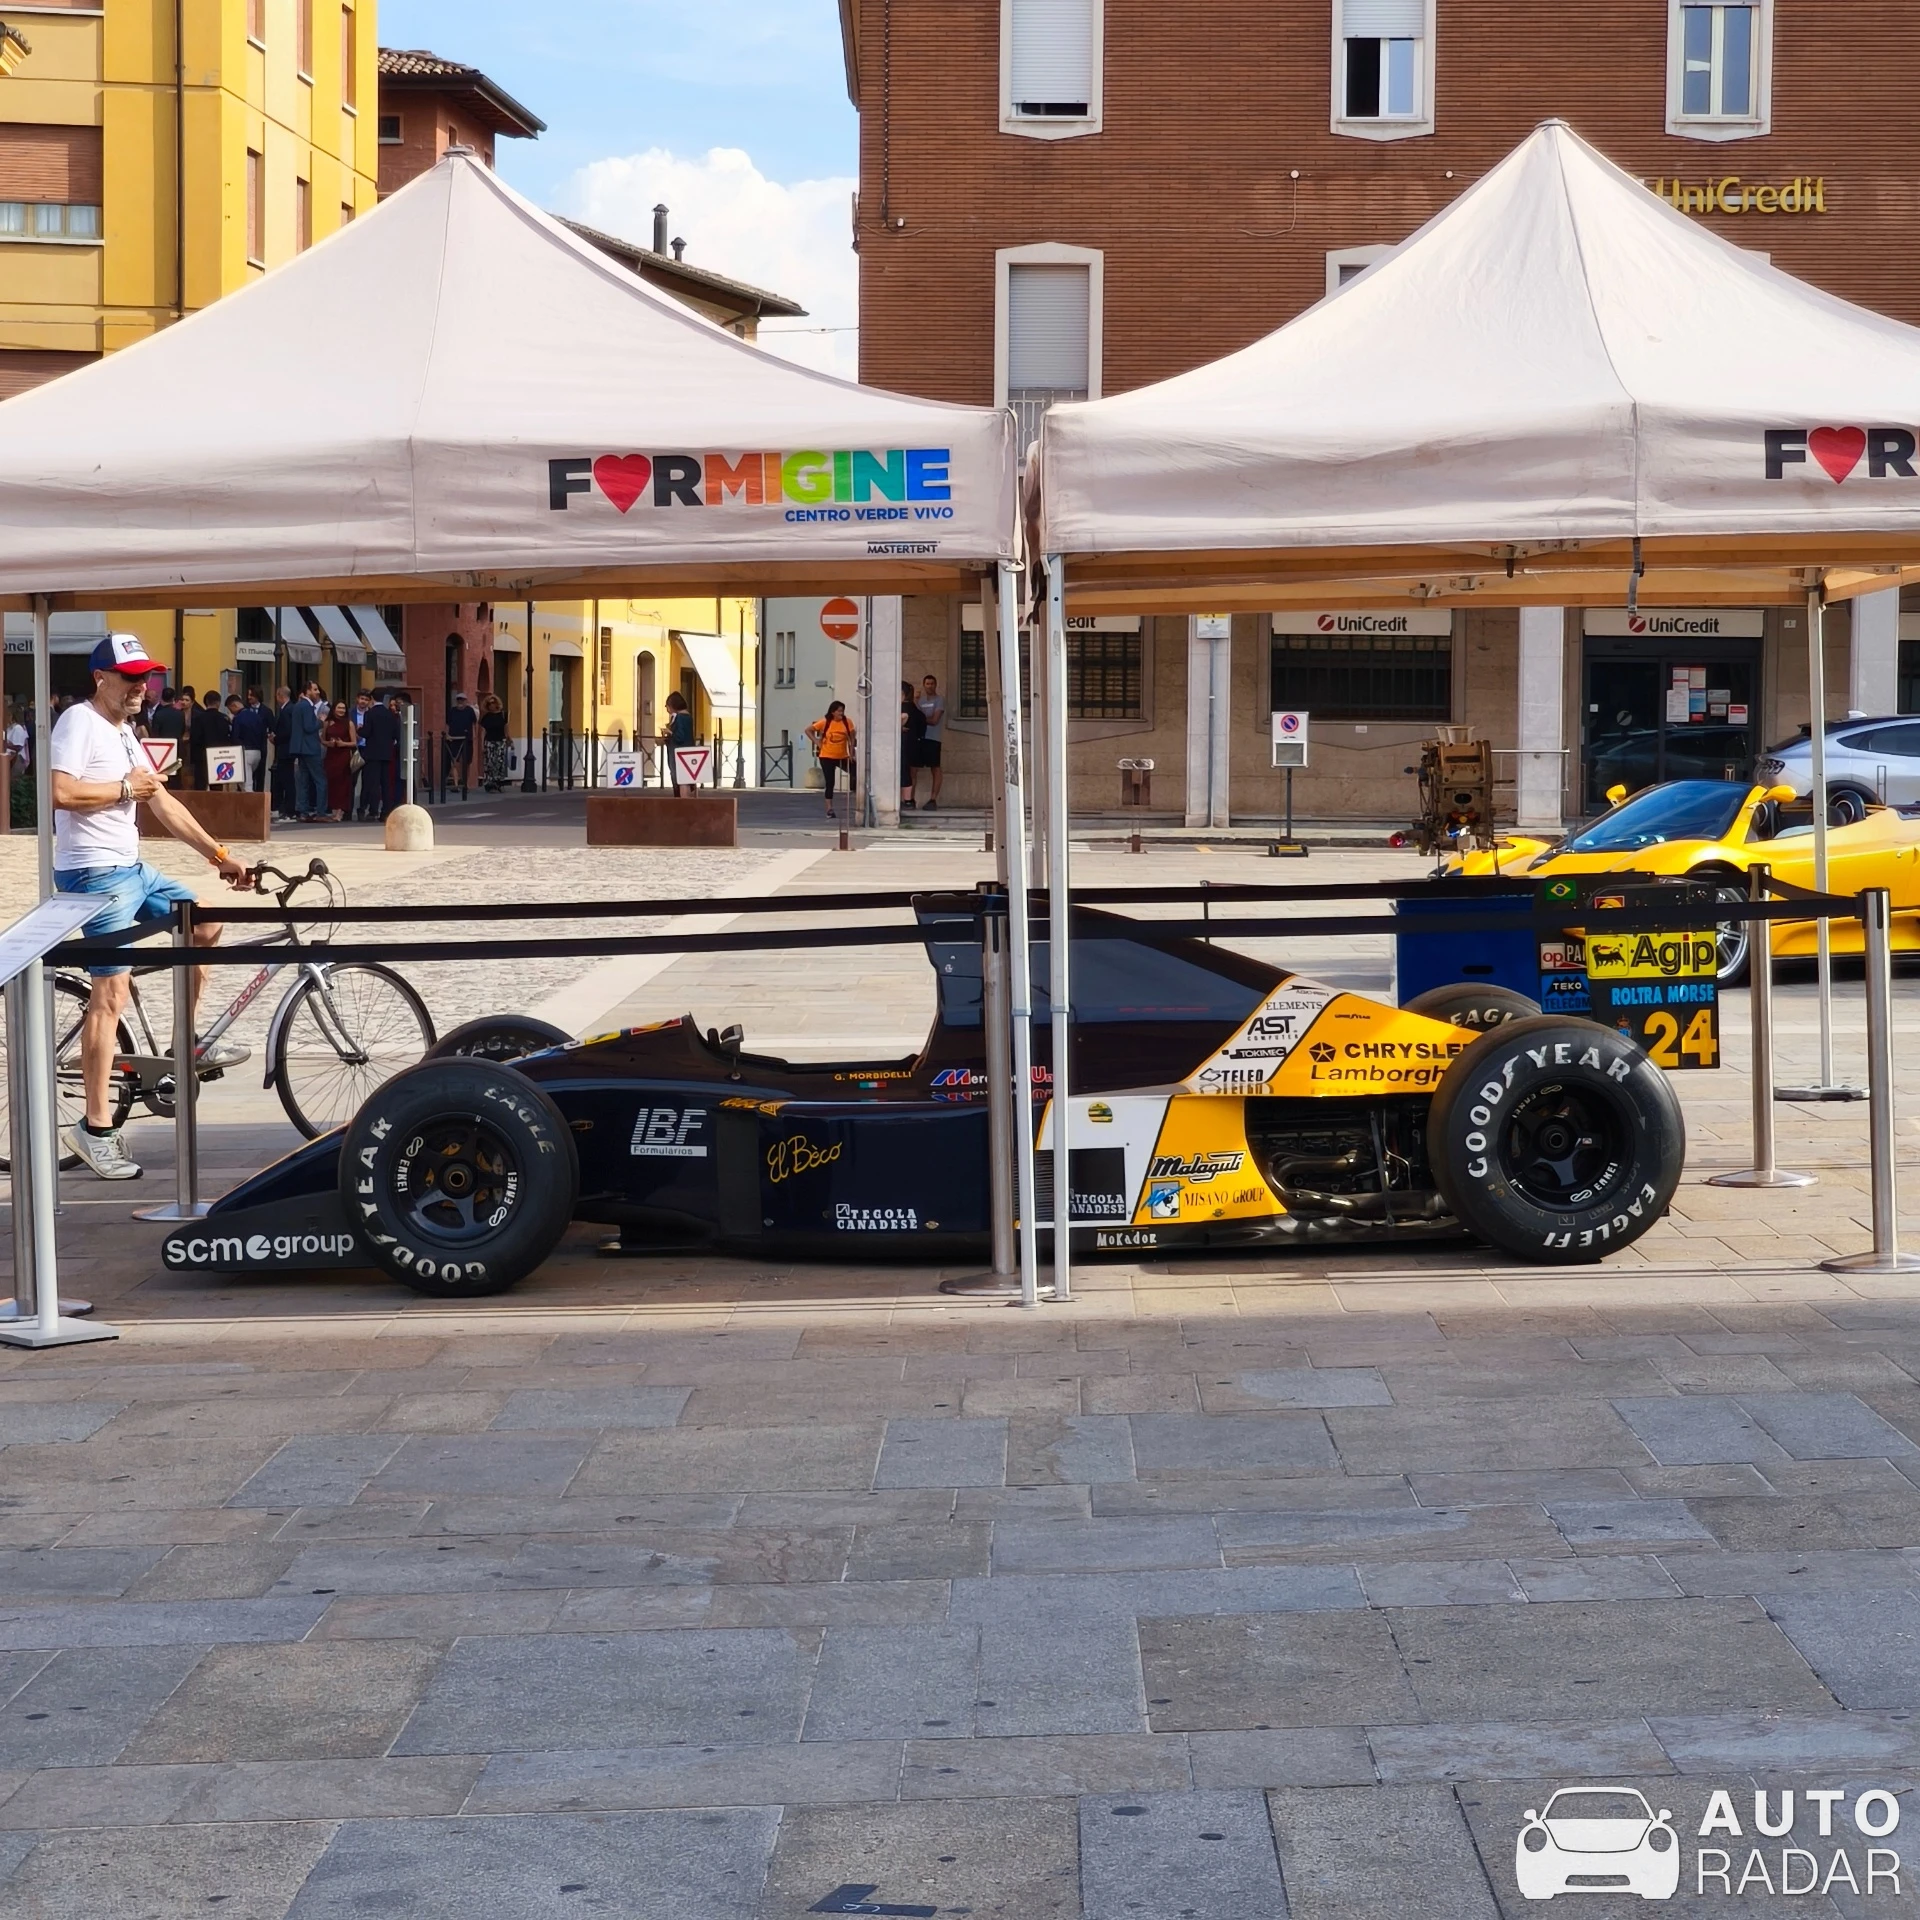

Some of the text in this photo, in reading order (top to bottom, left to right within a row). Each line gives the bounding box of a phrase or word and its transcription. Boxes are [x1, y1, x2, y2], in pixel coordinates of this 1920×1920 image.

[1655, 176, 1827, 213] UniCredit
[548, 448, 953, 514] FRMIGINE
[785, 506, 954, 523] CENTRO VERDE VIVO
[867, 543, 940, 555] MASTERTENT
[1337, 616, 1408, 632] UniCredit
[1649, 617, 1720, 634] UniCredit
[1631, 934, 1715, 975] Agip
[1553, 982, 1582, 990] TEKO
[1611, 984, 1715, 1005] ROLTRA MORSE
[1266, 1001, 1322, 1011] ELEMENTS
[1247, 1016, 1297, 1035] AST
[1644, 1009, 1717, 1067] 24
[1240, 1048, 1285, 1058] TOKIMEC
[849, 1071, 912, 1081] MORBIDELLI
[1311, 1064, 1446, 1086] Lamborgh
[631, 1108, 708, 1145] IBF
[1148, 1151, 1246, 1183] Malaguti
[1075, 1194, 1124, 1204] TEGOLA
[1184, 1188, 1265, 1206] MISANO GROUP
[850, 1208, 917, 1220] TEGOLA
[1071, 1204, 1125, 1214] ANADESE
[1578, 1182, 1657, 1248] EAGLE
[836, 1218, 918, 1230] CANADESE
[167, 1233, 355, 1264] scm group
